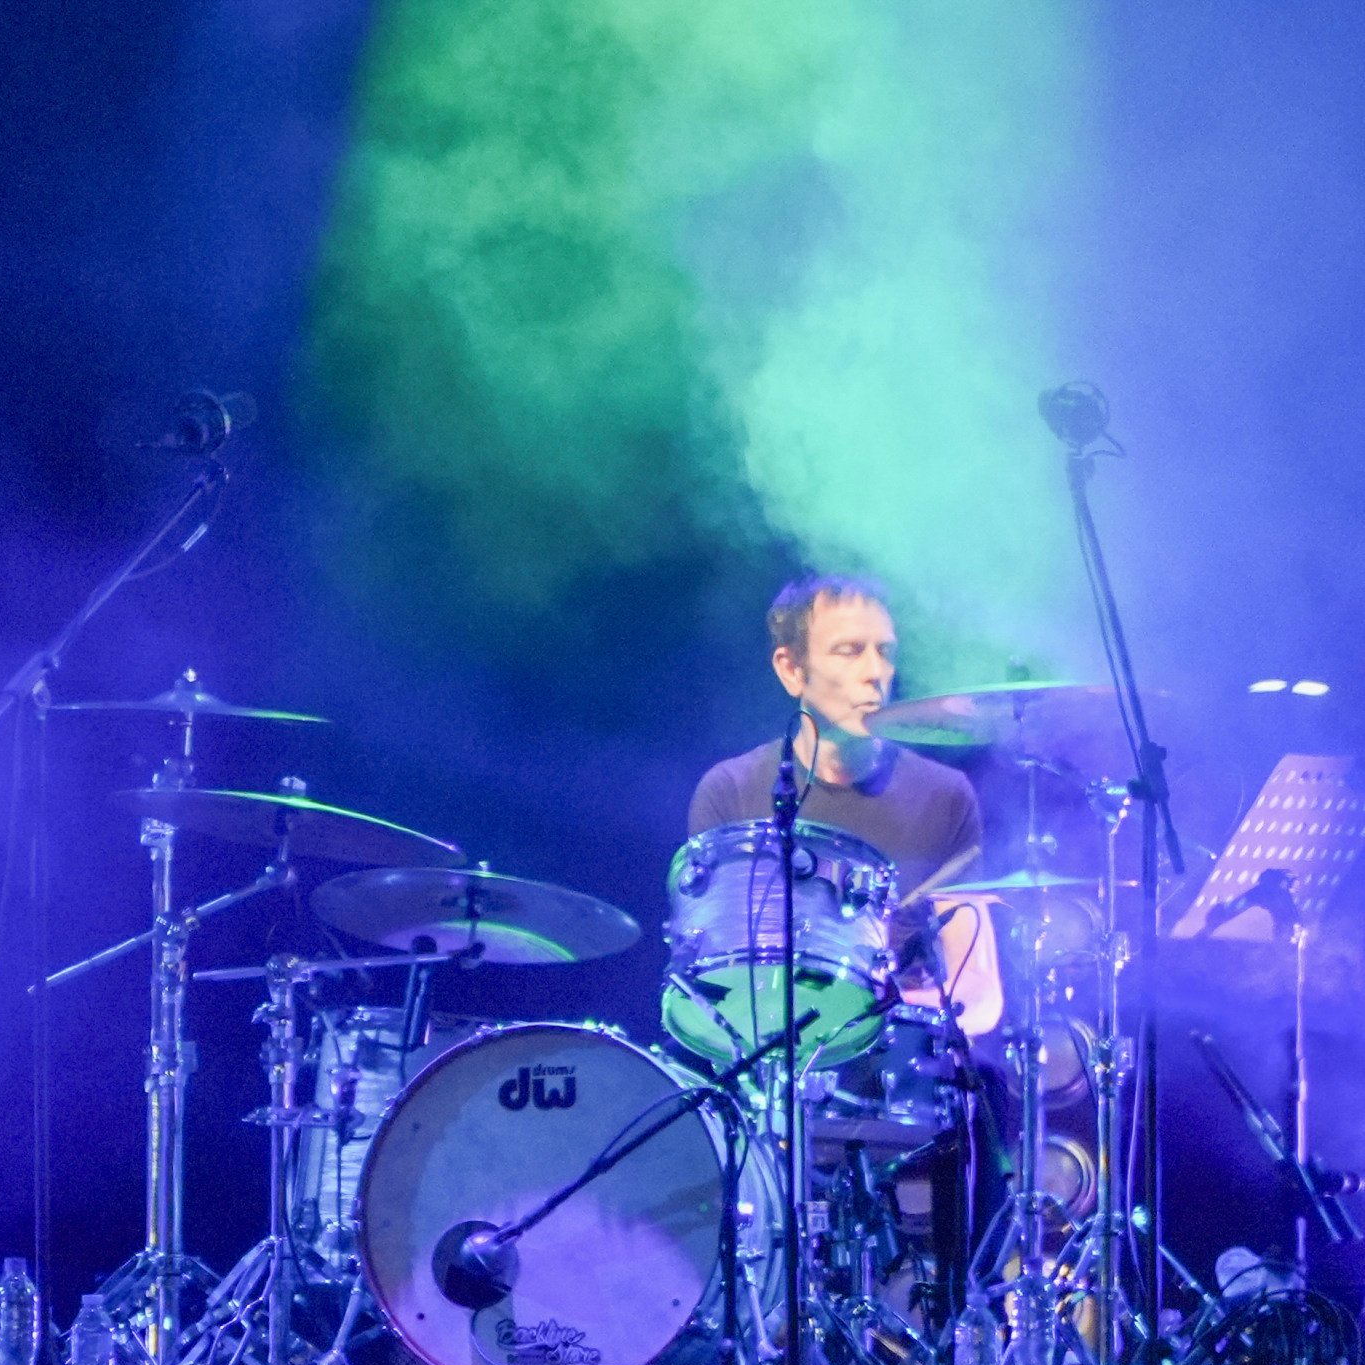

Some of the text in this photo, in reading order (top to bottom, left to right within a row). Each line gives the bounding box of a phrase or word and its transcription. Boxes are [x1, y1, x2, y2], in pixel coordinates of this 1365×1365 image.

[533, 1064, 575, 1076] drums
[498, 1066, 576, 1111] dw
[496, 1318, 586, 1346] Backline
[546, 1342, 601, 1365] Store
